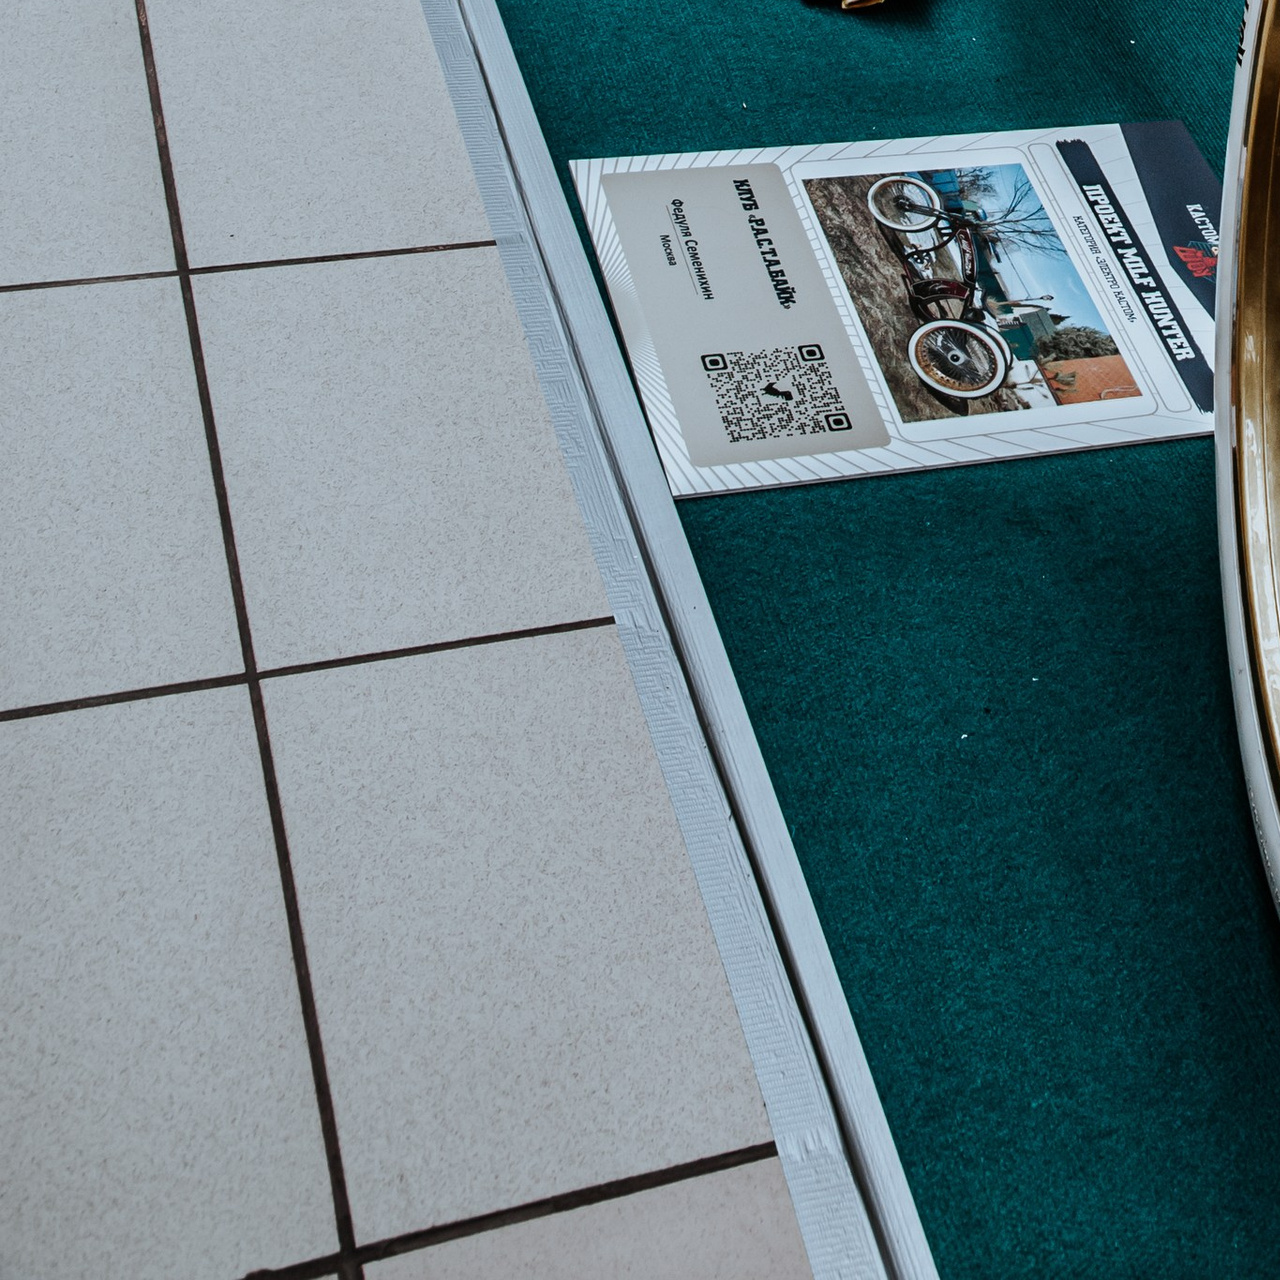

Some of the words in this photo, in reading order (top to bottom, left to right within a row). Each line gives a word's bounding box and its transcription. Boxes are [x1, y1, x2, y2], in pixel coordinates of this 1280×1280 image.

[732, 178, 760, 212] КЛУБ
[659, 234, 677, 266] Москва
[670, 197, 692, 237] Федуля
[684, 239, 714, 301] Семенихин
[1073, 215, 1102, 255] КАТЕГОРИЯ
[1082, 183, 1133, 245] ПРОЕКТ
[1117, 246, 1156, 288] MILF
[1141, 290, 1195, 363] HUNTER
